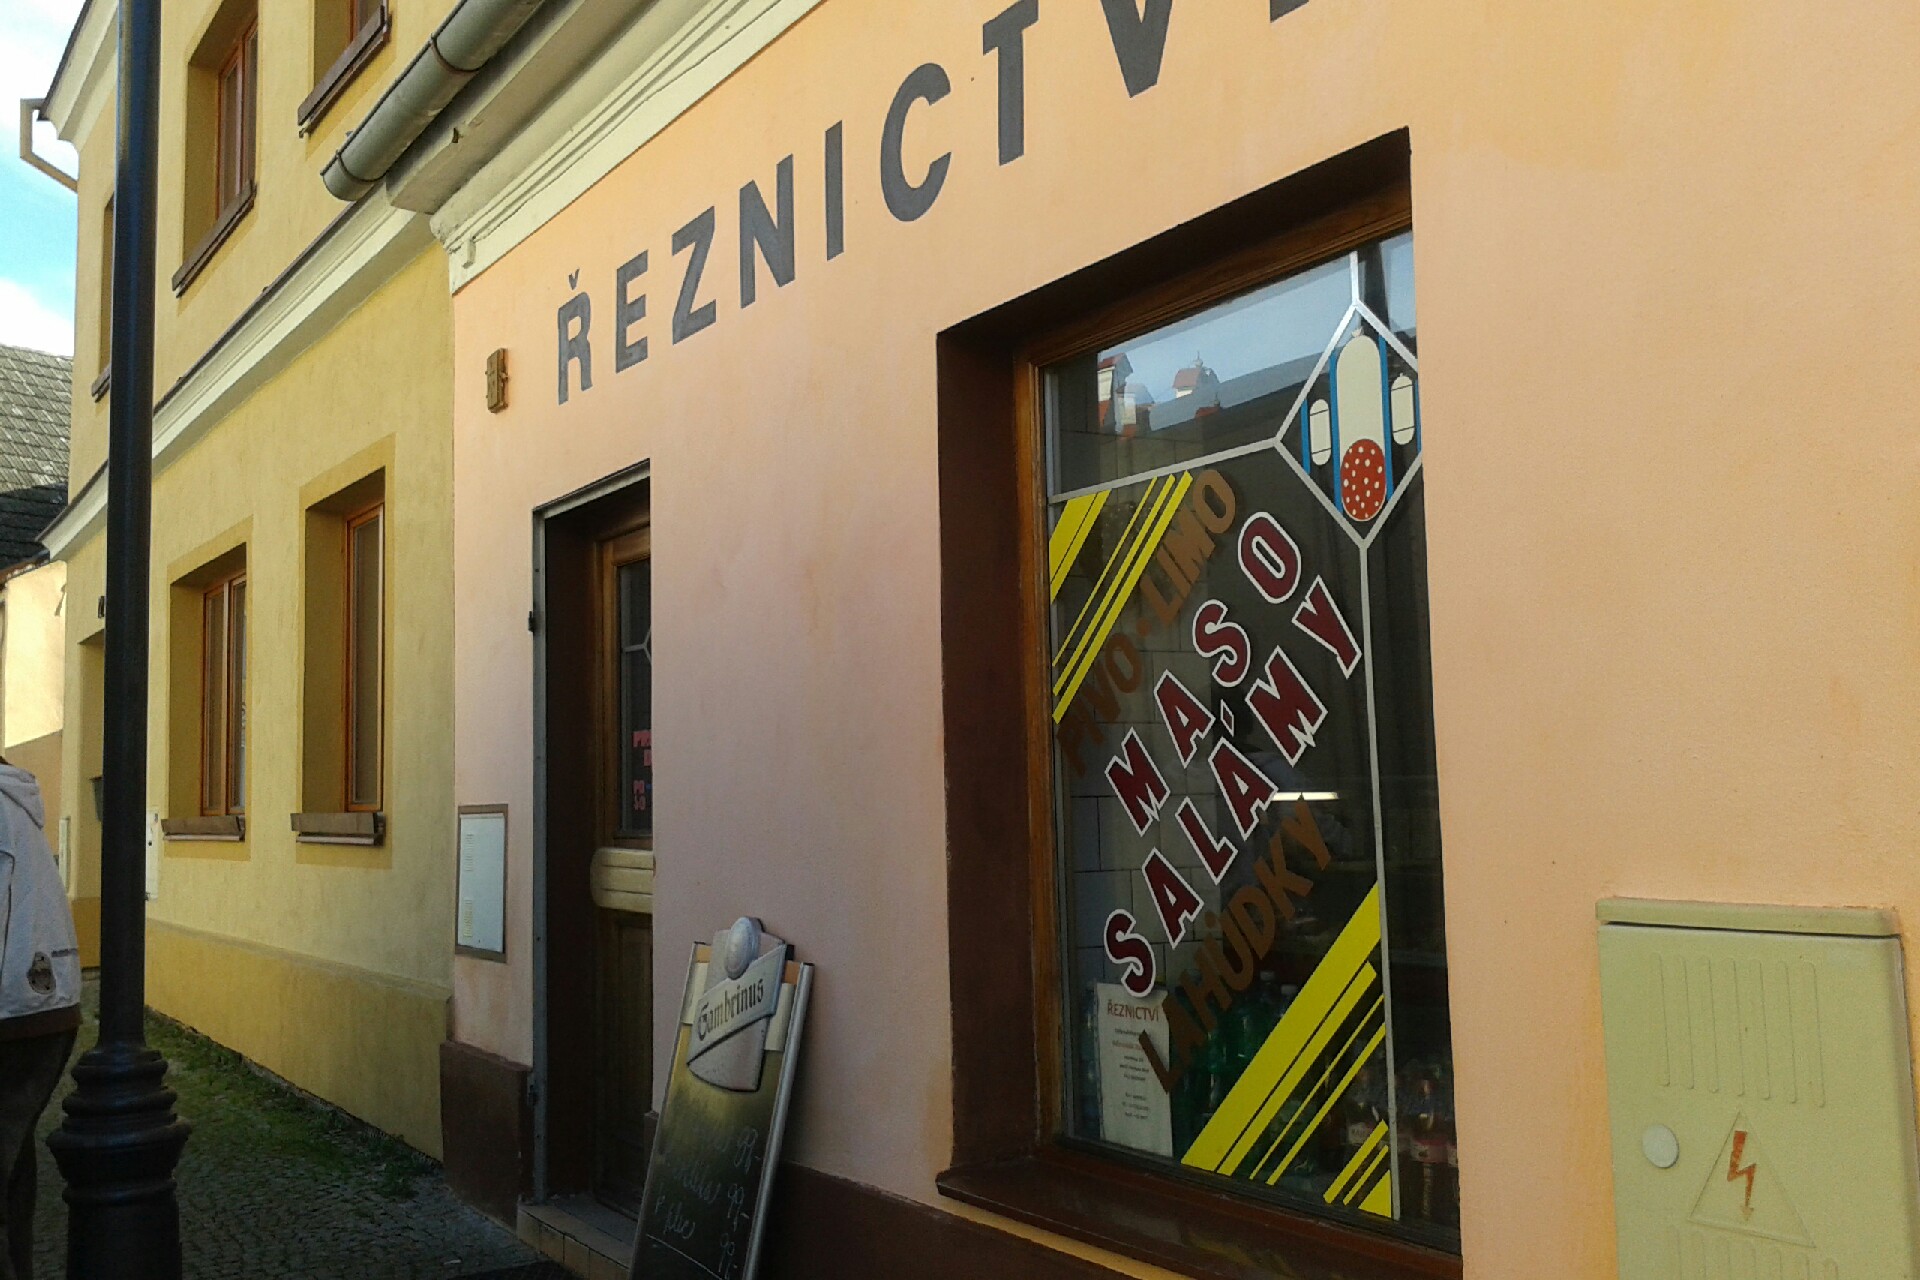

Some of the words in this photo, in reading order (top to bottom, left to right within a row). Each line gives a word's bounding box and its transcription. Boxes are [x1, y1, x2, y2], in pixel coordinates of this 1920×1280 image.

[557, 0, 1309, 406] ŘEZNICTV
[1104, 511, 1301, 837] MASO
[1139, 469, 1236, 625] LIMO
[1103, 574, 1362, 998] SALÁMY
[698, 978, 764, 1041] Gambrinus
